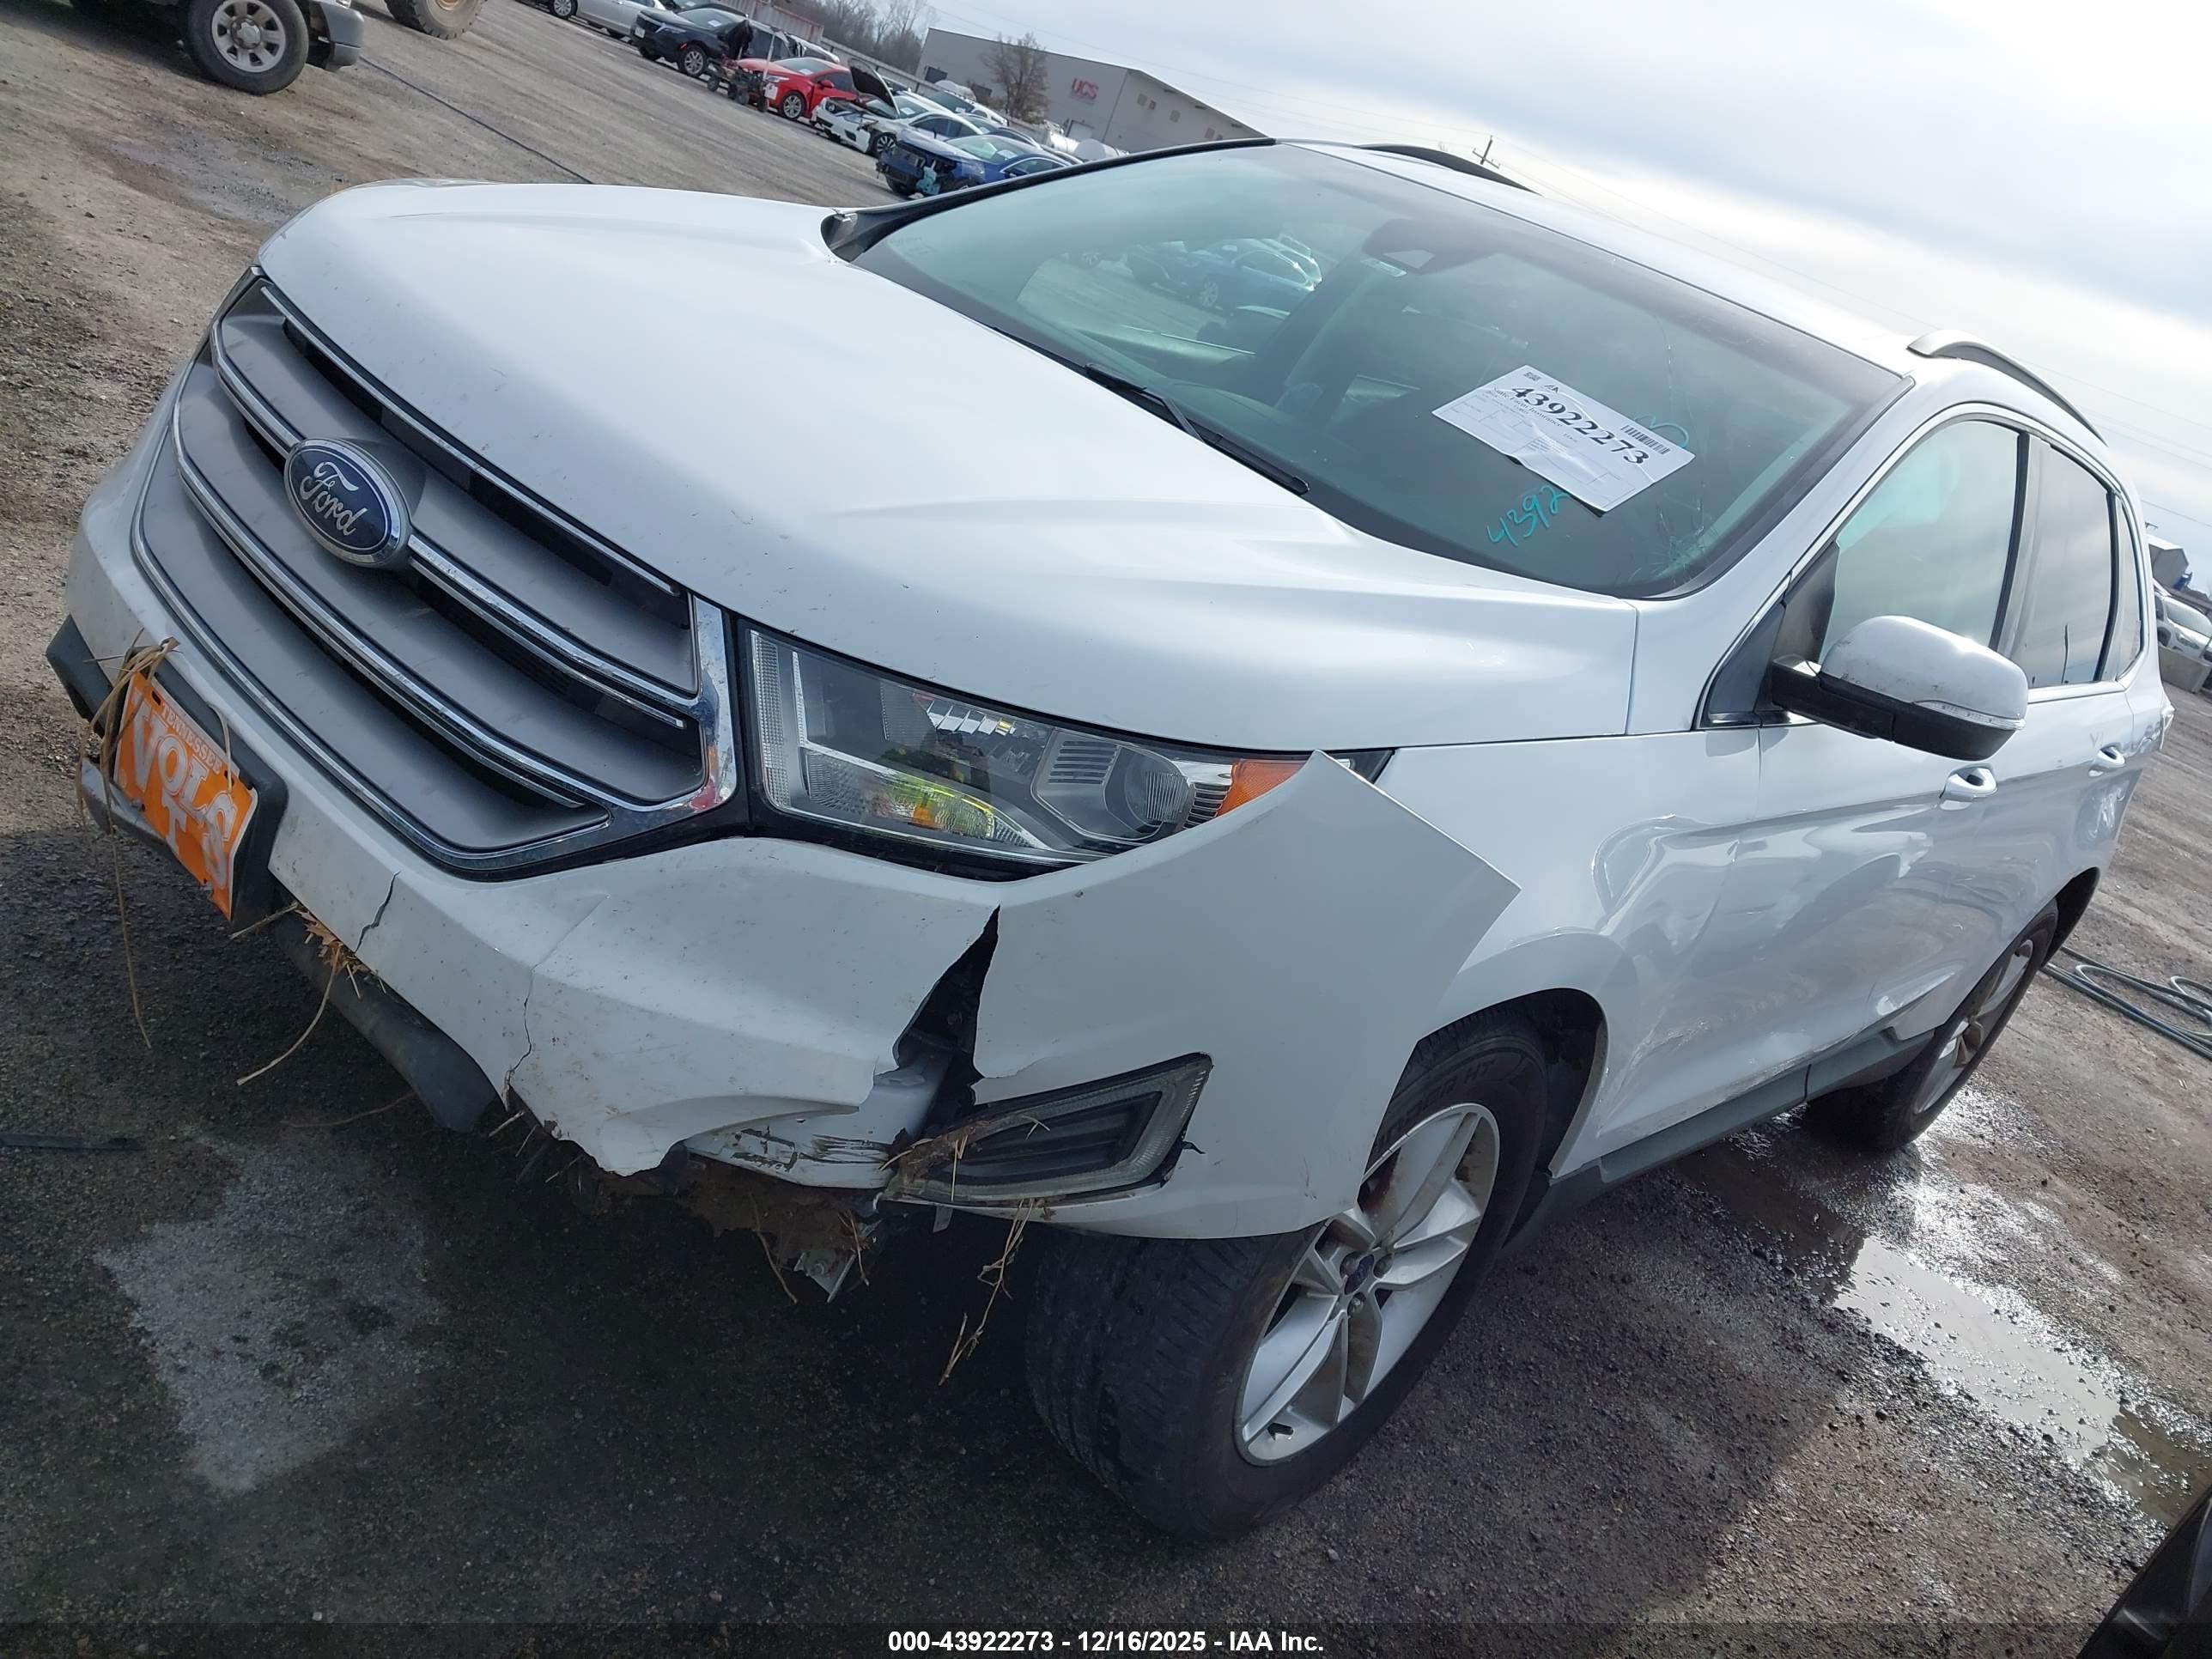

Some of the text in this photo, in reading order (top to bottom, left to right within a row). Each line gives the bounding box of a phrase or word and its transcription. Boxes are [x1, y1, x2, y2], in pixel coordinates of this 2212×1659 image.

[1072, 78, 1099, 100] UCS
[1511, 387, 1650, 465] 43922273
[301, 461, 368, 537] Ford
[161, 701, 222, 775] TENNESSEE
